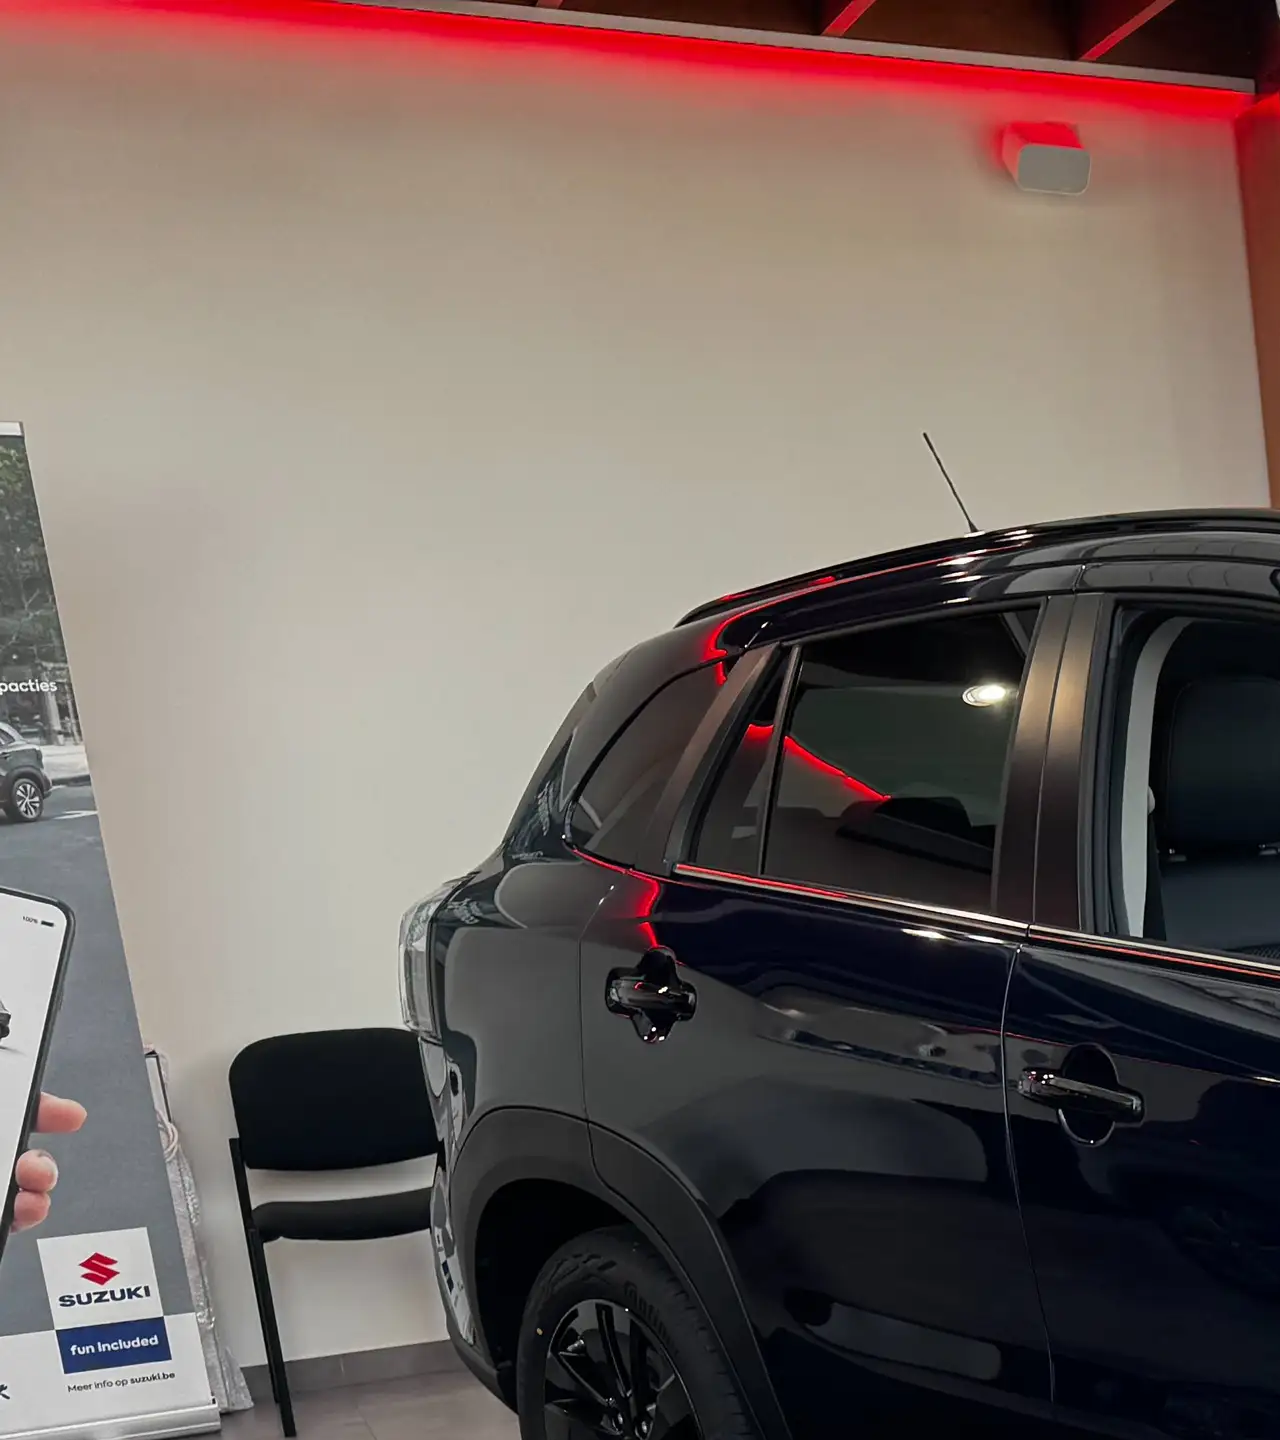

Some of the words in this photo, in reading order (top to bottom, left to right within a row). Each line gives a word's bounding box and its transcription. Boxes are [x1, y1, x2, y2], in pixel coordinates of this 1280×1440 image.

[58, 1285, 151, 1308] SUZUKI
[70, 1344, 95, 1356] fun
[67, 1384, 92, 1393] Meer
[94, 1379, 114, 1390] info
[115, 1379, 129, 1388] op
[130, 1372, 175, 1385] suzuki.be
